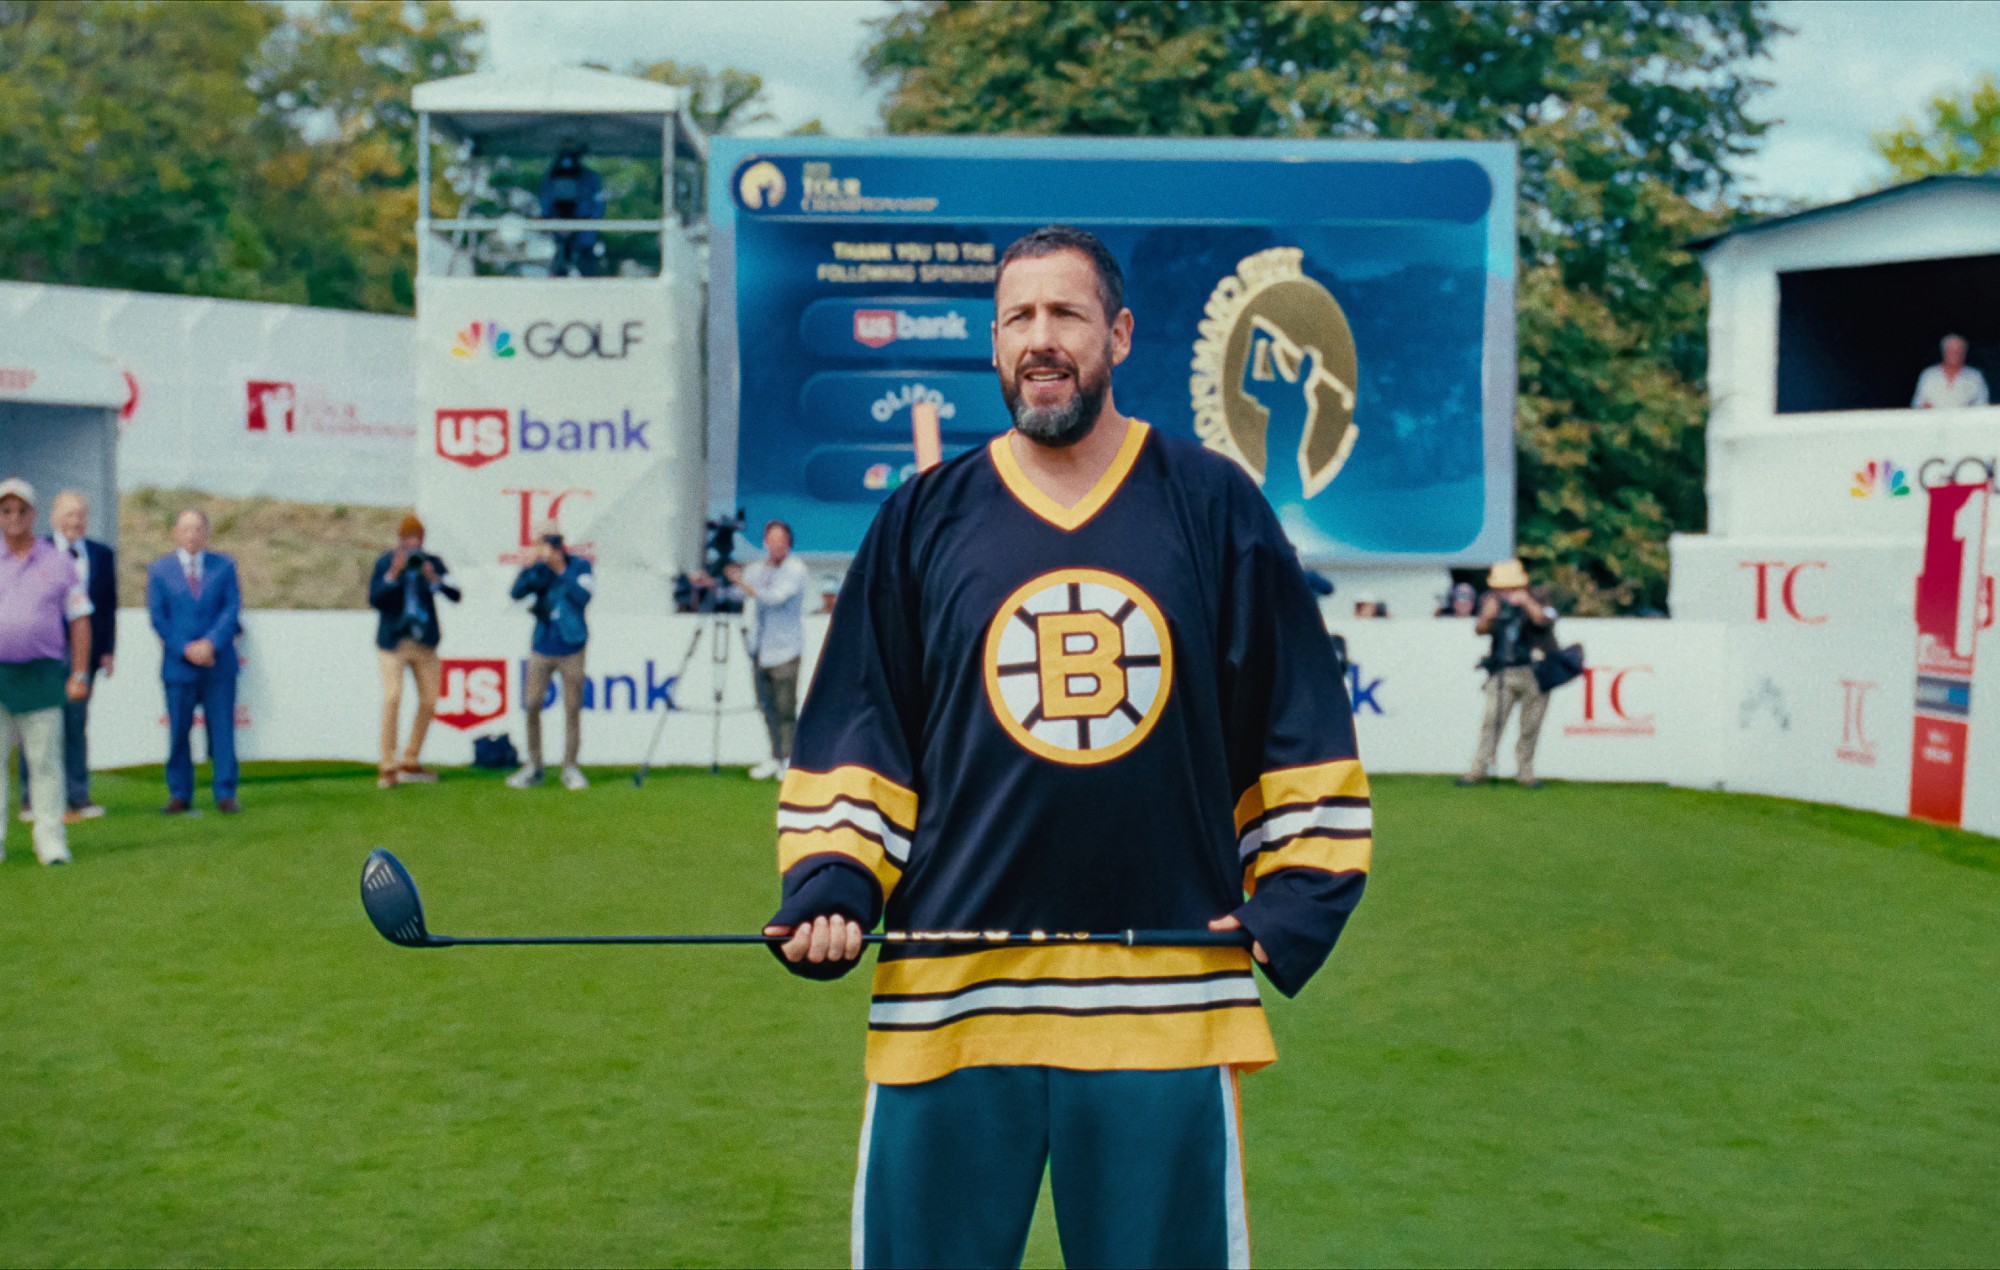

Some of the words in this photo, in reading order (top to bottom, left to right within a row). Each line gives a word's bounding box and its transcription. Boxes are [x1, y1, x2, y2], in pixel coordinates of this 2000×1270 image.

[833, 241, 893, 261] THANK
[895, 242, 933, 262] YOU
[934, 242, 960, 262] TO
[961, 242, 996, 261] THE
[817, 263, 916, 283] FOLLOWING
[918, 264, 998, 283] SPONSOR
[523, 320, 645, 359] GOLF
[896, 310, 968, 340] bank
[518, 406, 651, 452] bank
[1738, 559, 1830, 625] TC
[1036, 609, 1128, 721] B
[1582, 664, 1656, 724] TC
